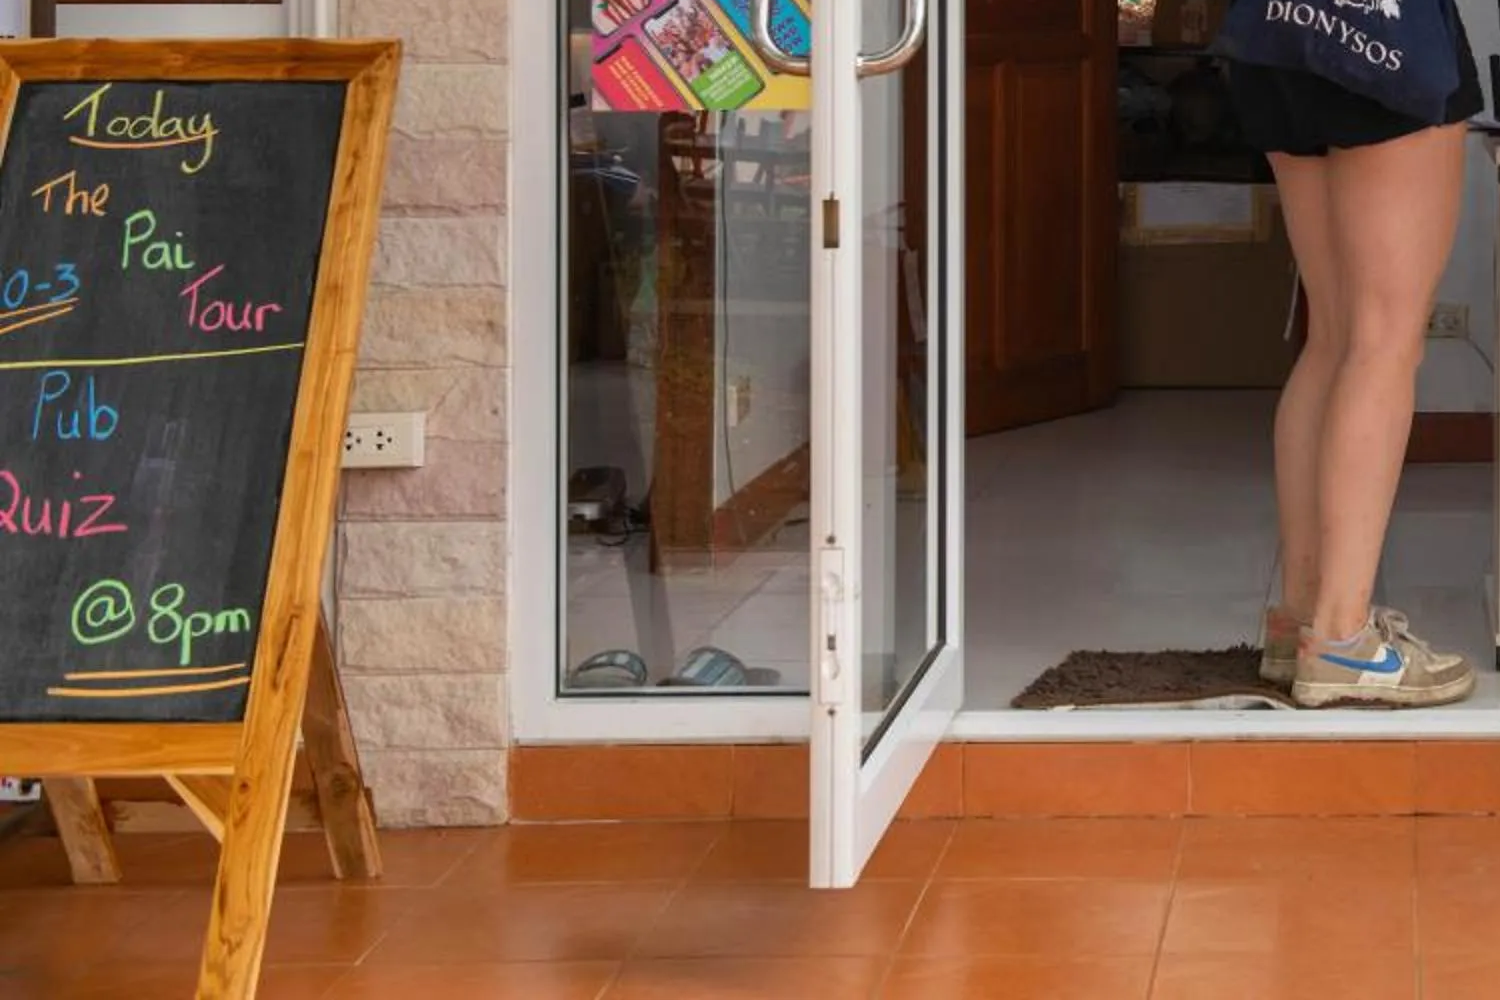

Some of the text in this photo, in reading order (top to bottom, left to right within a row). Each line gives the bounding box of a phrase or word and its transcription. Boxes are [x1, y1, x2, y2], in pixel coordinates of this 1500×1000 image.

[1265, 0, 1403, 72] DIONYSOS
[63, 82, 220, 174] Today
[32, 169, 110, 217] The
[121, 209, 196, 270] Pai
[179, 264, 283, 332] Tour
[32, 369, 119, 441] Pub
